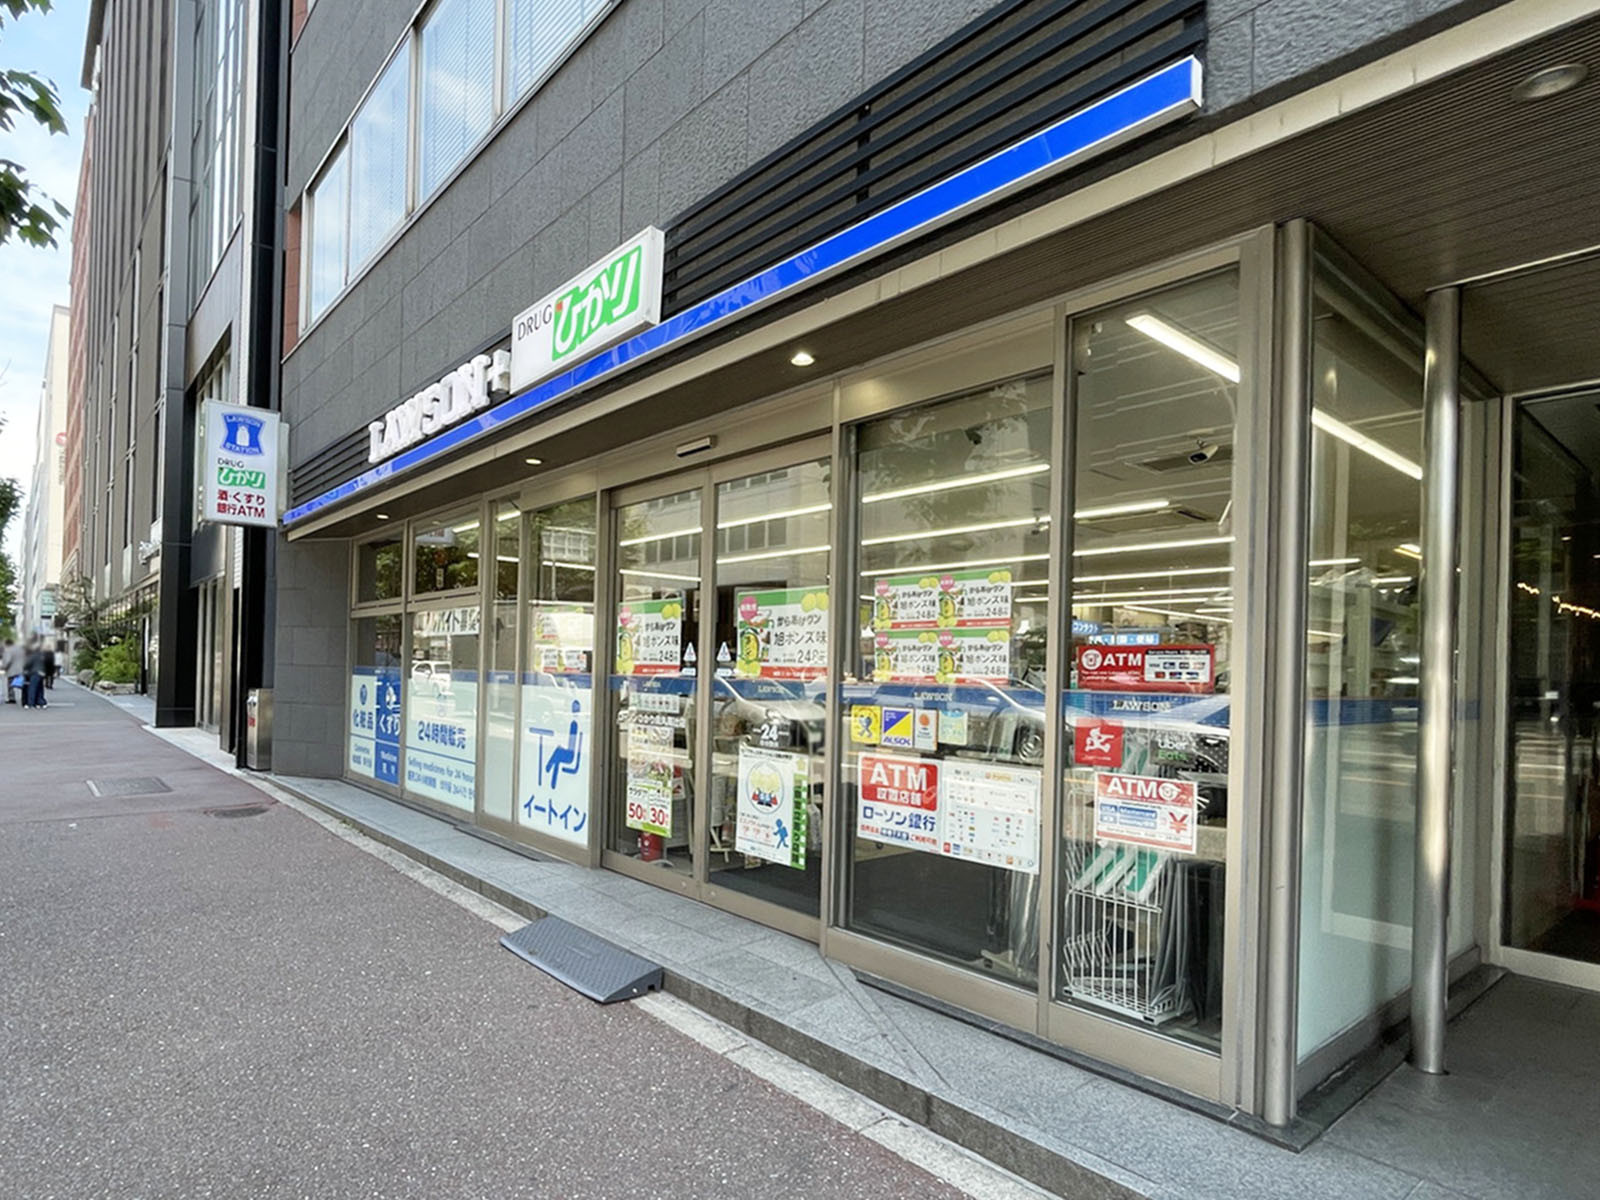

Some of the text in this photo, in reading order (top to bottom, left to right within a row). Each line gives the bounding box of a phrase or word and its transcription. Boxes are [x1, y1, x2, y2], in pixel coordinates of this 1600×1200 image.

[555, 250, 639, 355] ひかり
[517, 303, 552, 342] DRUG
[368, 354, 491, 464] LAWSON
[224, 441, 262, 456] STATION
[217, 458, 245, 469] DRUG
[218, 467, 266, 490] ひかり
[216, 502, 266, 518] 銀行ATM
[1103, 653, 1142, 667] ATM
[1112, 699, 1172, 713] LAWSON
[379, 713, 401, 737] くすり
[761, 723, 778, 741] 24
[883, 737, 911, 745] ALSOK
[869, 762, 927, 791] ATM
[1106, 777, 1158, 799] ATM
[523, 794, 587, 832] イートイン
[628, 802, 643, 820] 50
[650, 807, 665, 826] 30
[863, 806, 936, 832] ローソン銀行
